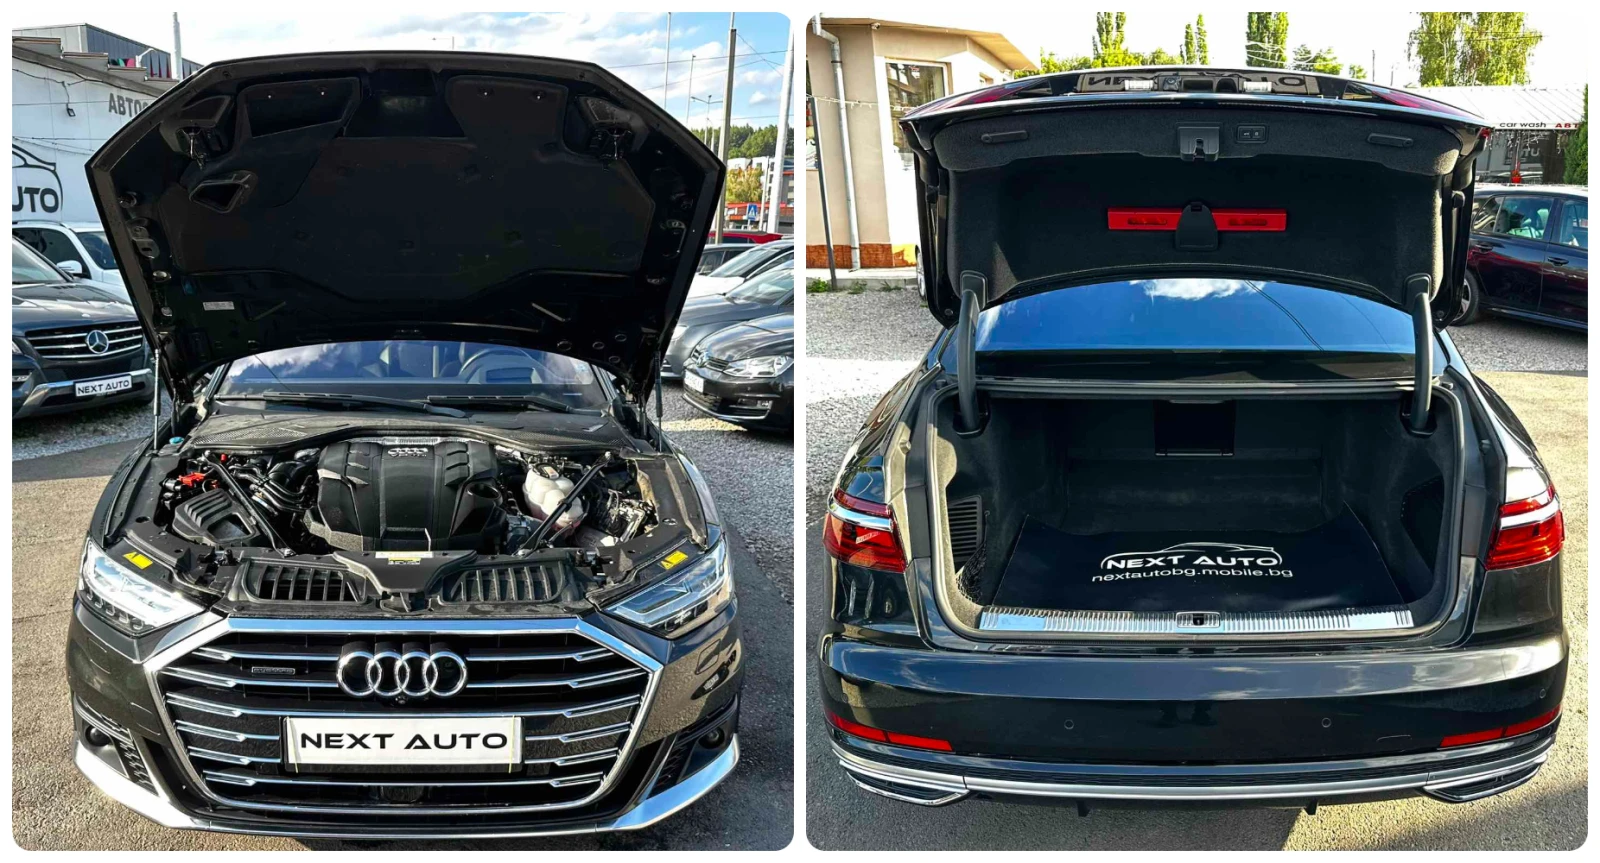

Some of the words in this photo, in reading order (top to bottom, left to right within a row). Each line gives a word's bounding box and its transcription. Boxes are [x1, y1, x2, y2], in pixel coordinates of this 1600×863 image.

[78, 384, 103, 395] NEXT
[105, 380, 130, 391] AUTO
[1106, 555, 1185, 569] NEXT
[1192, 555, 1278, 567] AUTO
[1091, 568, 1293, 582] nextautobg.mobile.bg
[301, 733, 394, 749] NEXT
[404, 733, 508, 750] AUTO
